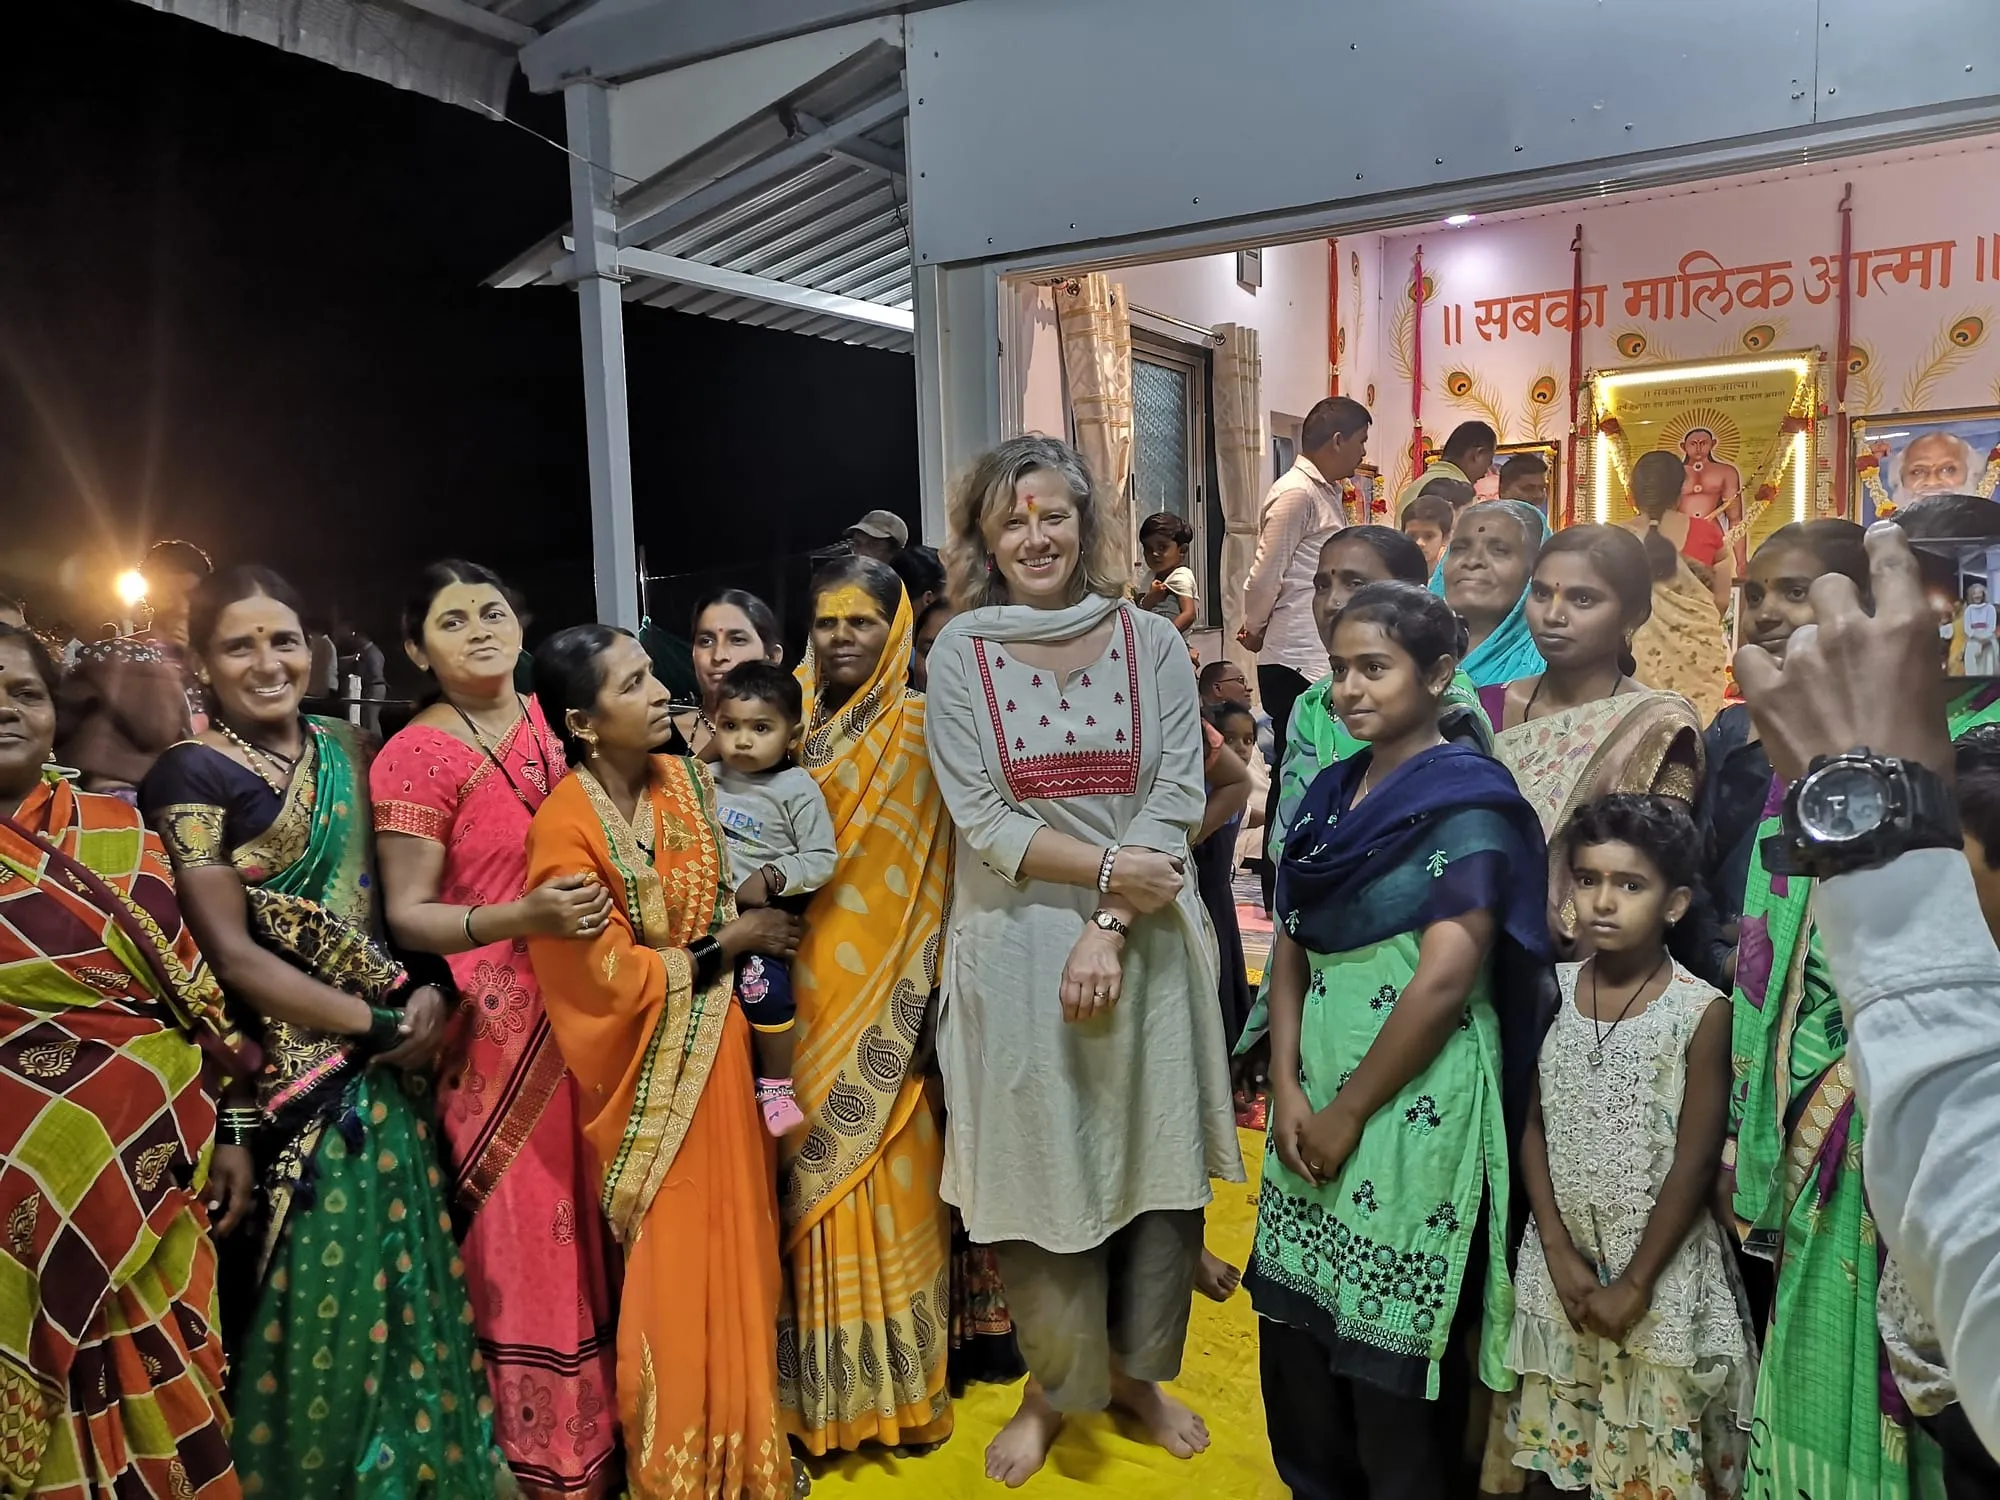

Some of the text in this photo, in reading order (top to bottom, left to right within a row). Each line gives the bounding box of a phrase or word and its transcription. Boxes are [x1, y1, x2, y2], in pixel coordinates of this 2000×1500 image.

[1474, 284, 1608, 341] सबका
[1622, 250, 1793, 323] मालिक
[1803, 240, 1957, 304] आत्मा
